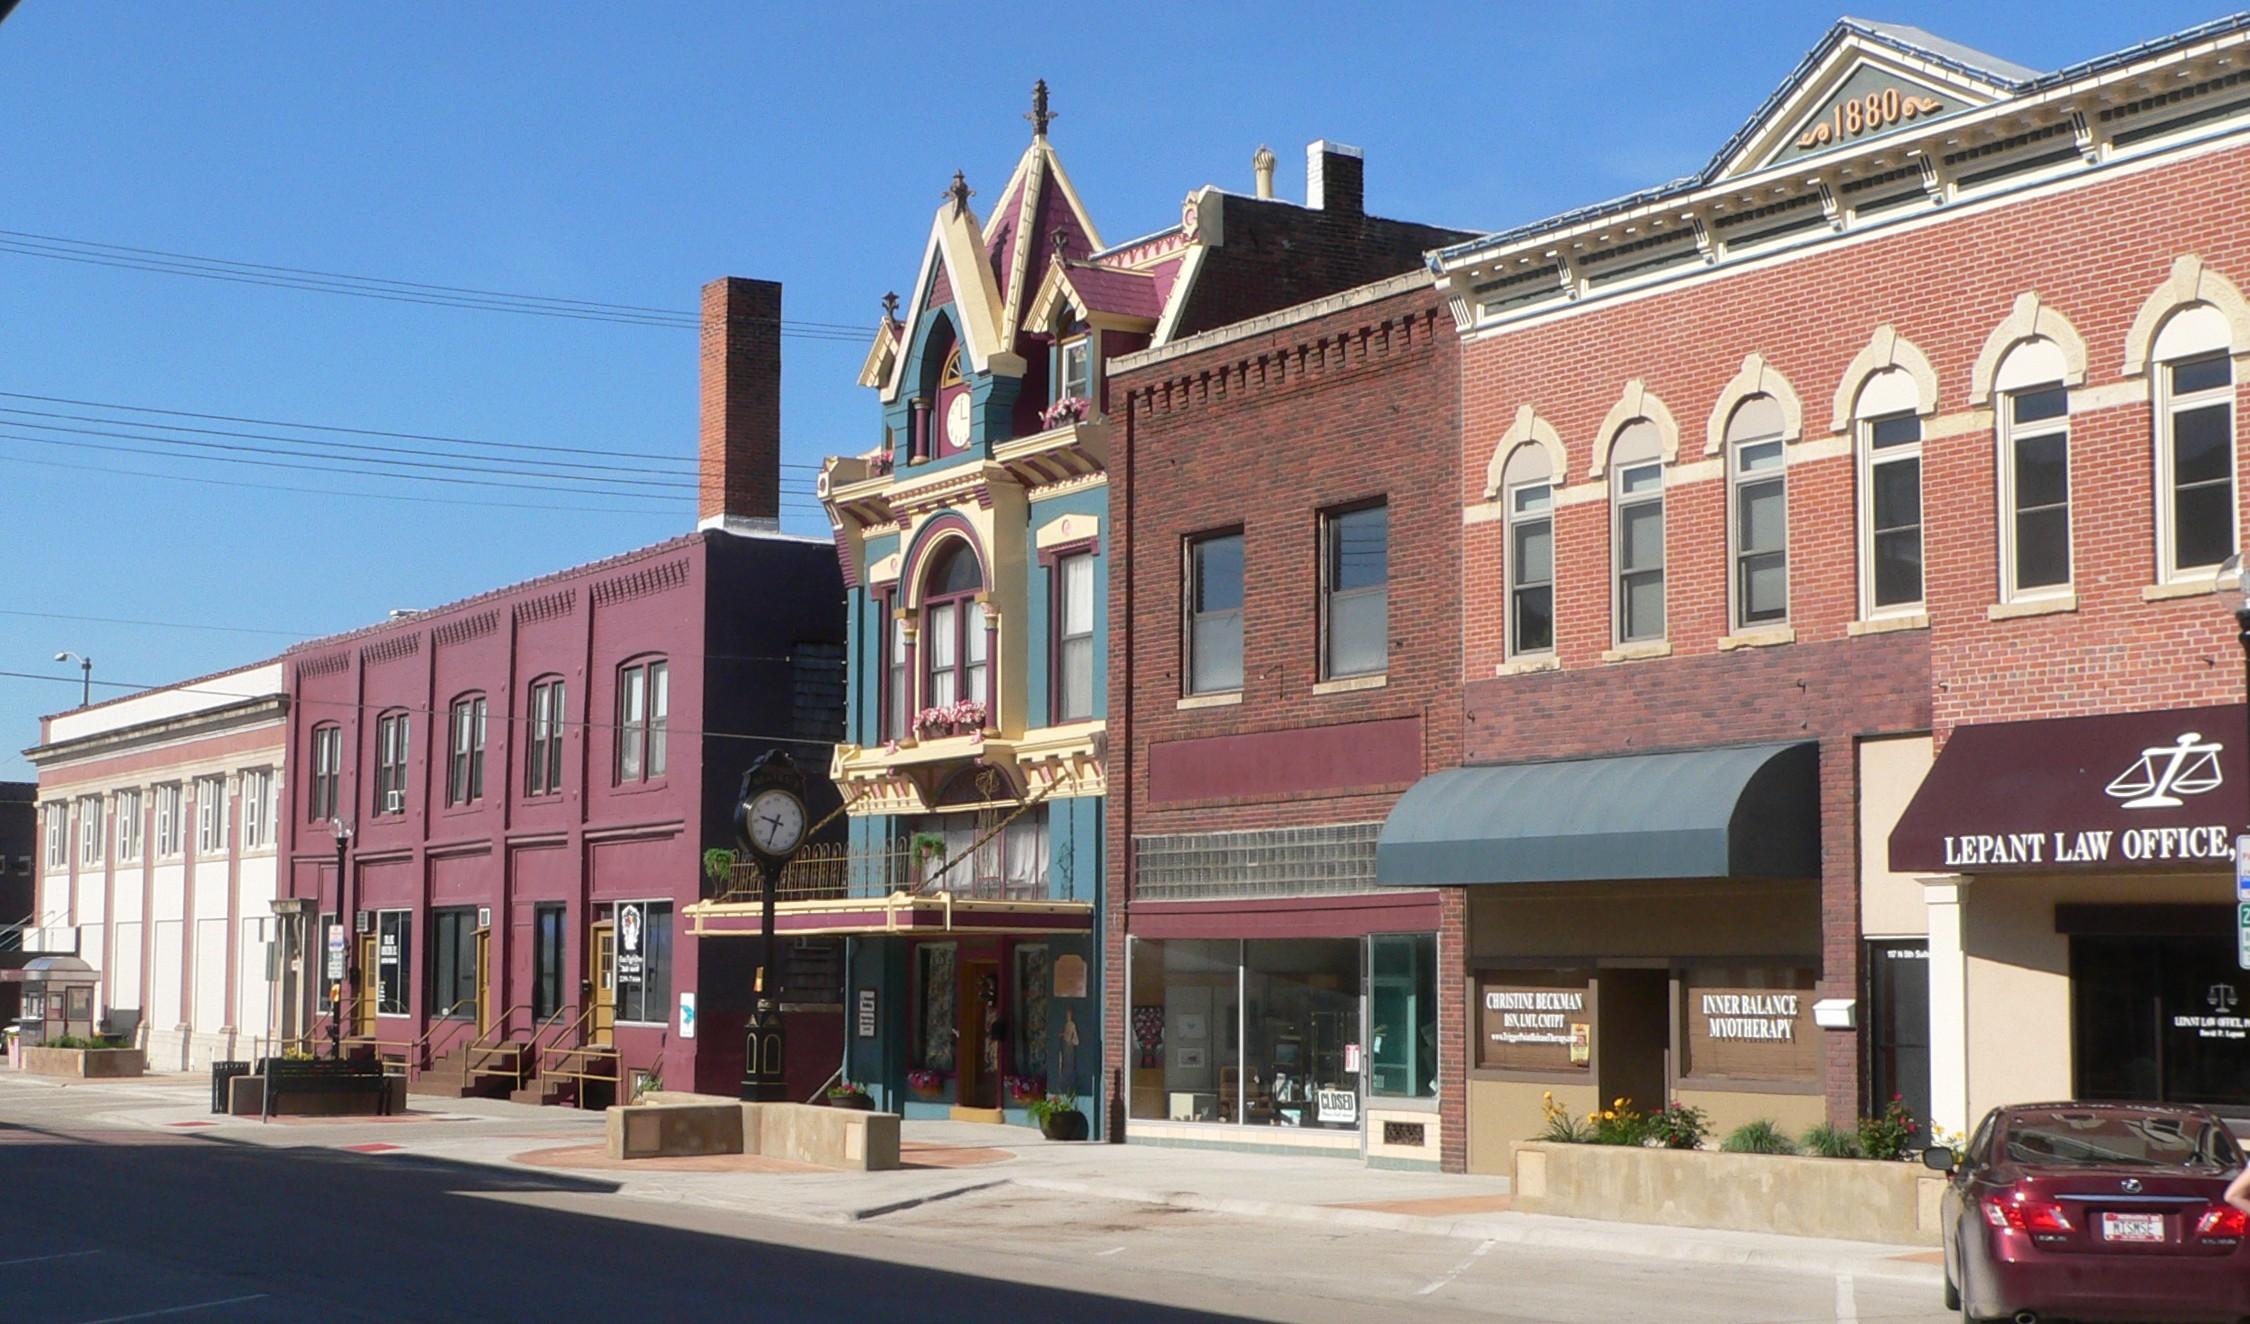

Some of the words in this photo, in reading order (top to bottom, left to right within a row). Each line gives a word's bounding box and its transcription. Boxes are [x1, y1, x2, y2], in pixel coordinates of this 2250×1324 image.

[1834, 88, 1900, 139] 1880
[1944, 833, 2045, 865] LEPANT
[2054, 830, 2112, 862] LAW
[2122, 826, 2236, 862] OFFICE,
[1486, 992, 1534, 1009] CHRISTINE
[1536, 993, 1582, 1010] BECKMAN
[1702, 994, 1740, 1015] INNER
[1741, 994, 1798, 1015] BALANCE
[1709, 1017, 1793, 1039] MYOTHERAPY
[2174, 1016, 2200, 1027] LEPANT
[2201, 1016, 2216, 1027] LAW
[1321, 1093, 1353, 1110] CLOSED
